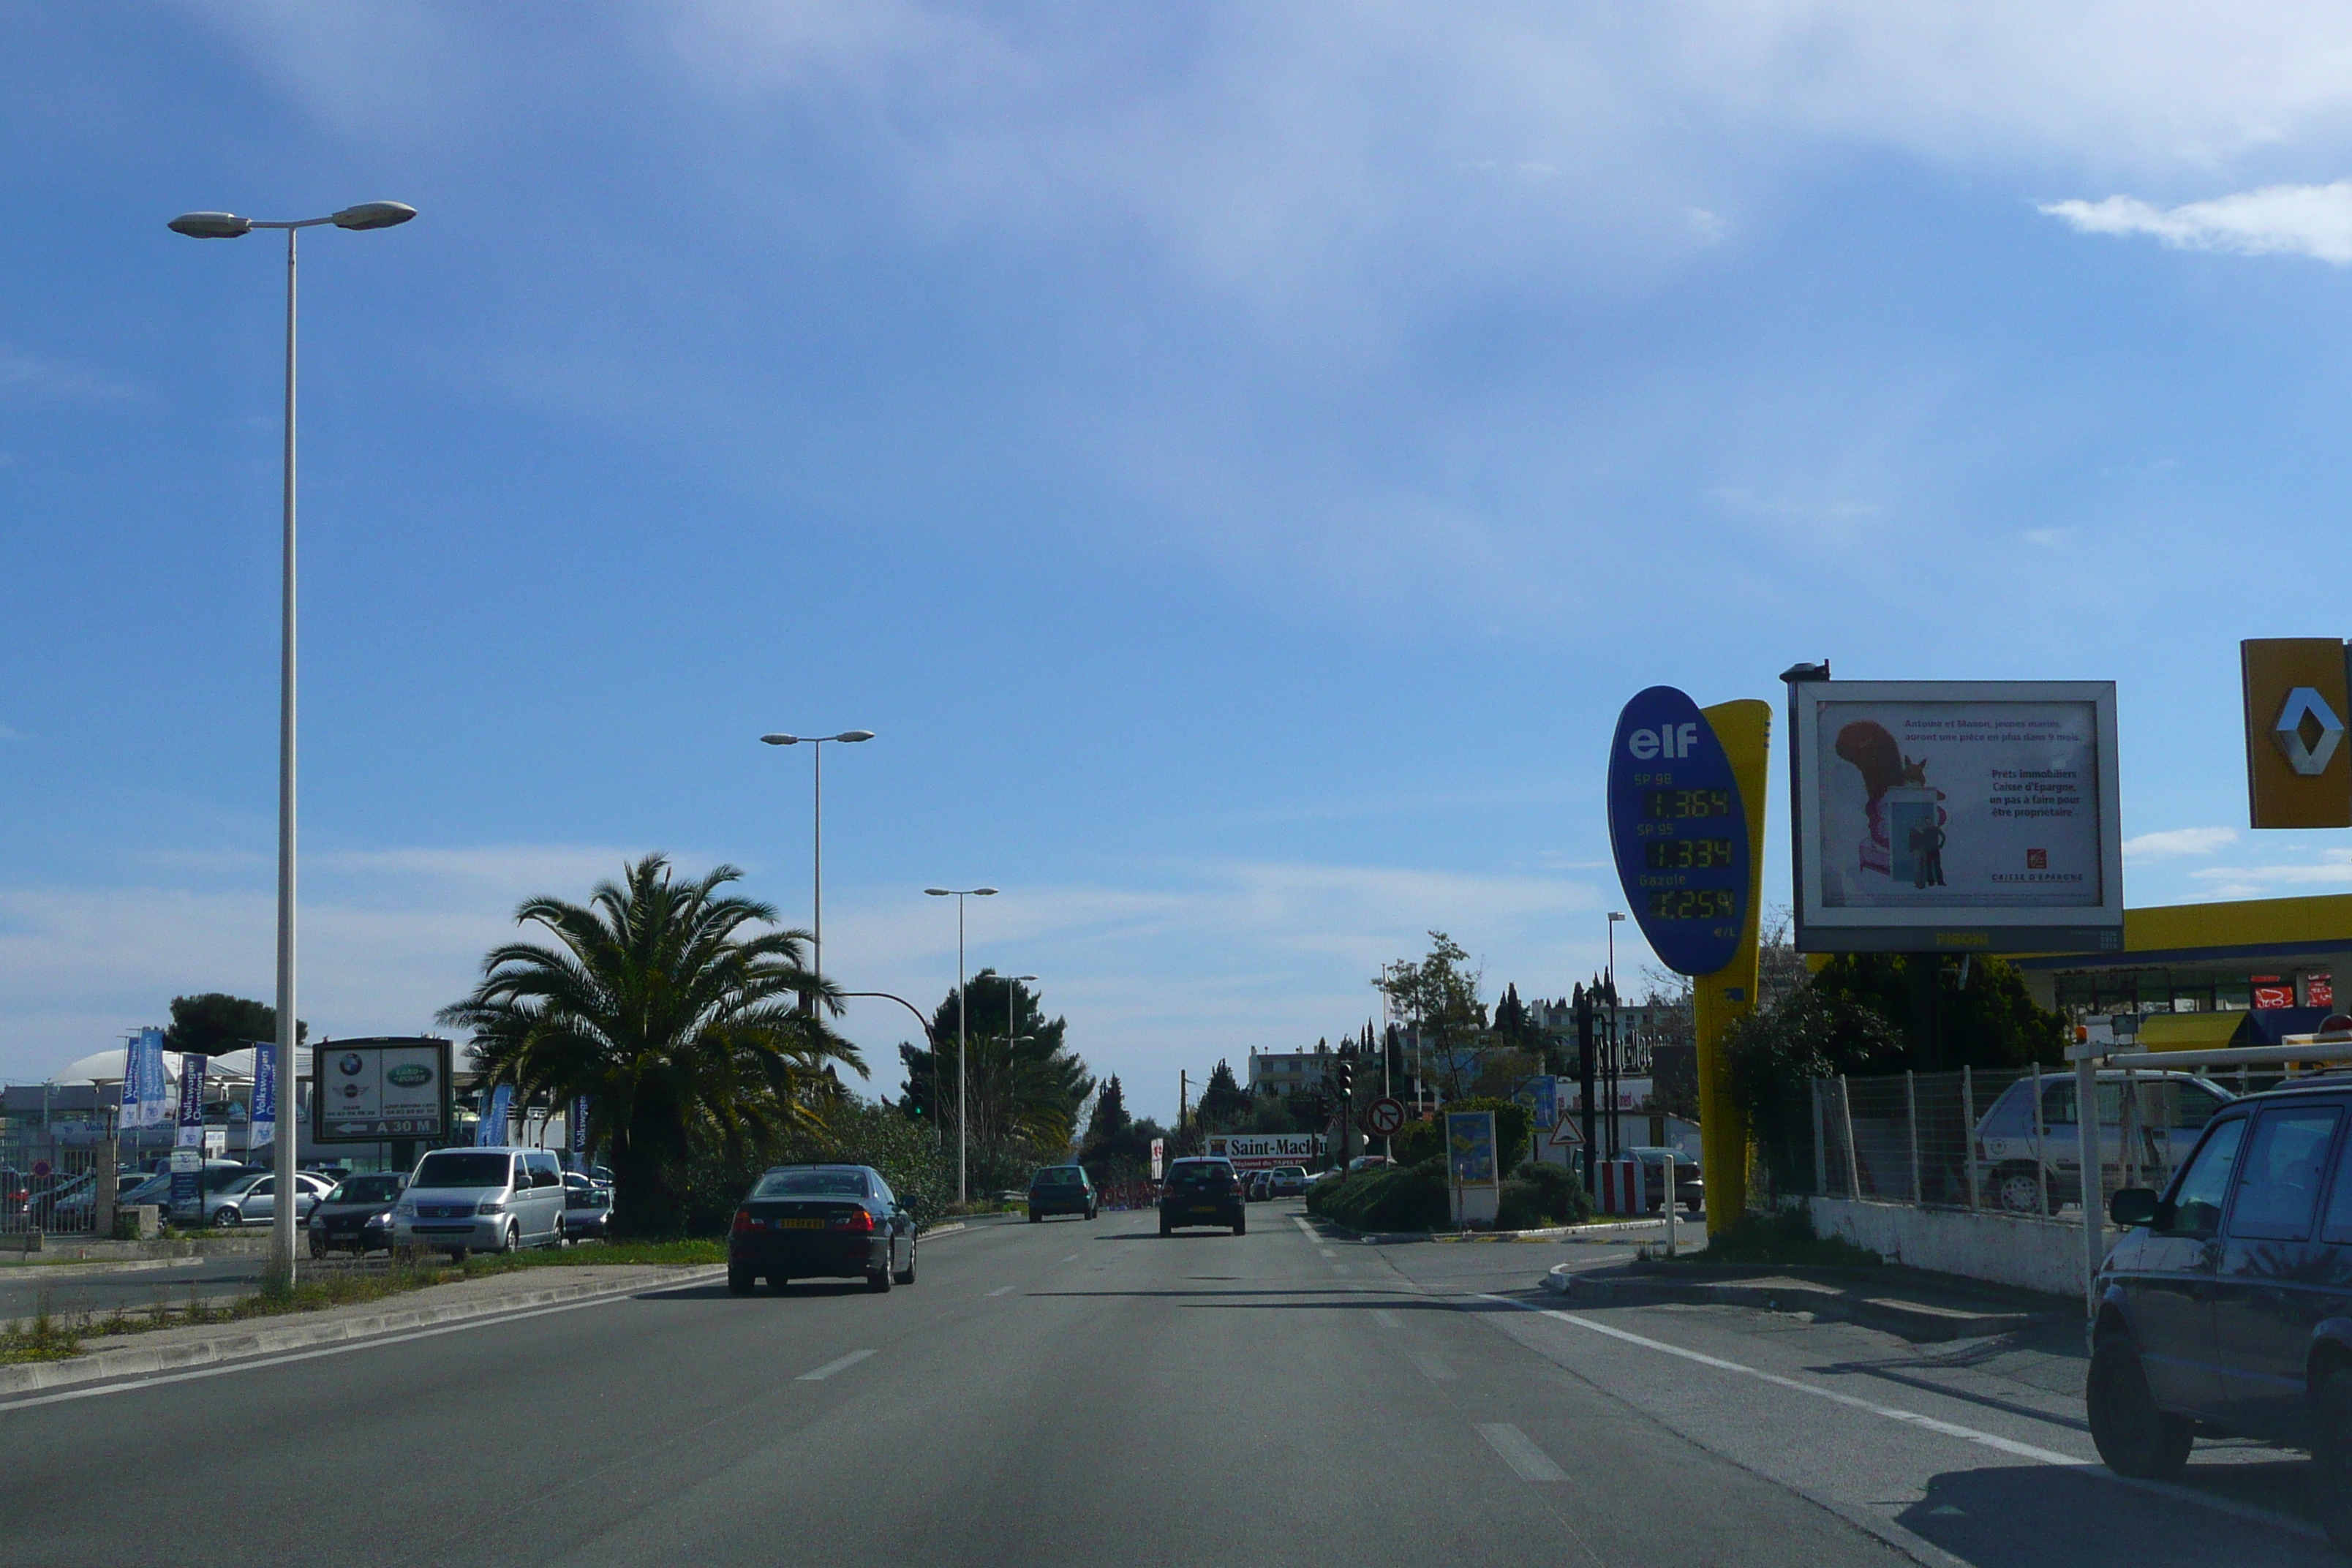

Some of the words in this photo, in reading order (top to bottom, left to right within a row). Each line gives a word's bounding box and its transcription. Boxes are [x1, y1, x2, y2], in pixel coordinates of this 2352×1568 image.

[1904, 720, 1942, 728] Antoine
[1994, 720, 2026, 730] jeunes
[1629, 722, 1698, 760] elf
[1959, 733, 1985, 742] pièce
[2001, 733, 2021, 742] plus
[2023, 733, 2046, 741] dans
[2048, 733, 2054, 741] 9
[1635, 773, 1651, 785] SP
[1655, 772, 1673, 785] 98
[1991, 769, 2017, 778] Prêts
[2019, 769, 2077, 778] immobiliers
[1993, 782, 2023, 791] Caisse
[1990, 796, 2002, 804] un
[2004, 796, 2021, 806] pas
[2024, 794, 2029, 804] à
[2032, 794, 2055, 804] faire
[2057, 796, 2081, 805] pour
[1991, 807, 2014, 817] être
[1637, 824, 1654, 836] SP
[1658, 823, 1674, 835] 95
[1639, 875, 1686, 887] Gazole
[124, 1044, 139, 1098] Volkswagen
[143, 1037, 152, 1096] Volkswagen
[255, 1050, 271, 1115] Volkswagen
[184, 1061, 197, 1120] Volkswagen
[193, 1071, 203, 1120] Occasions
[377, 1121, 388, 1132] A
[393, 1121, 412, 1131] 30
[417, 1120, 430, 1131] M
[1232, 1139, 1327, 1156] Saint-Maclu
